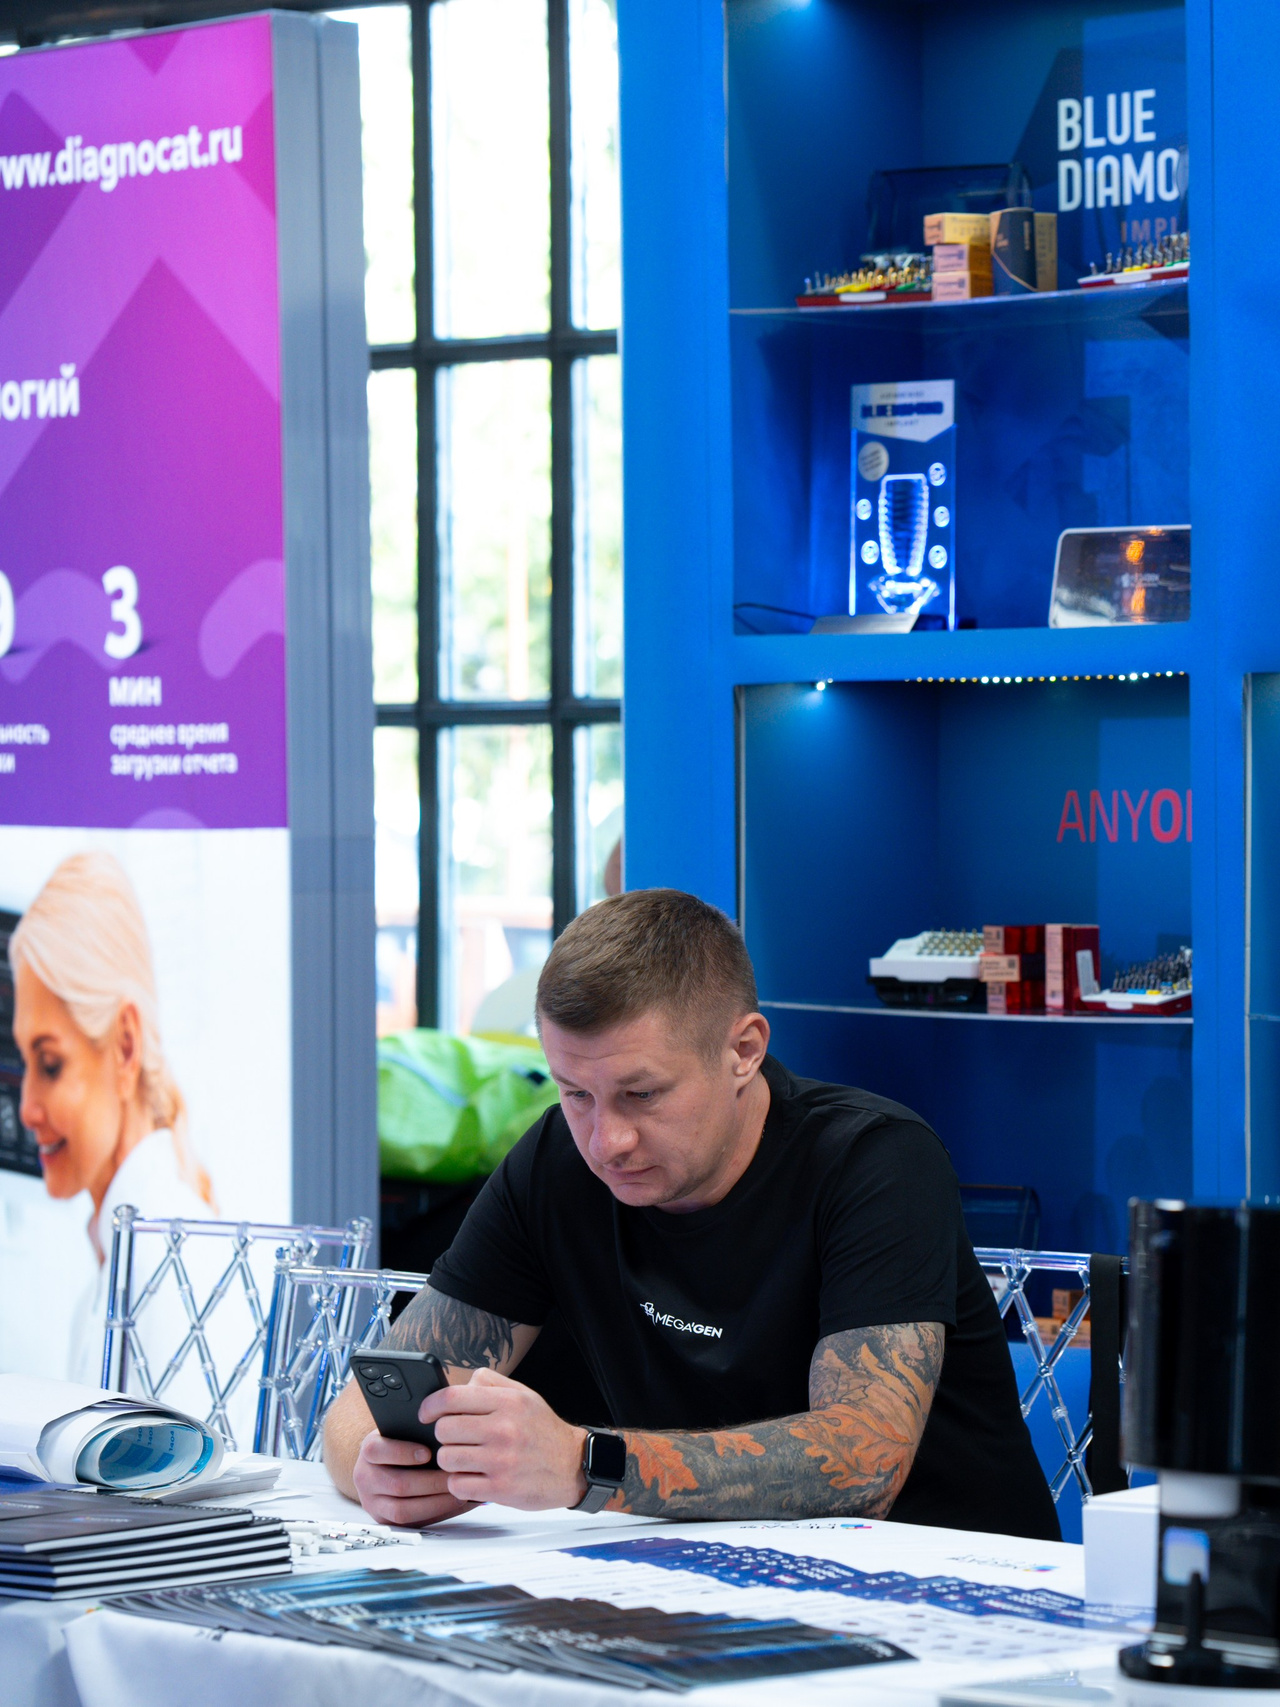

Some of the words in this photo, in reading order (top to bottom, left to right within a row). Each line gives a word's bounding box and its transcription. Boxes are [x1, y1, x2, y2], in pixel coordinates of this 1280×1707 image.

[1058, 88, 1156, 151] BLUE
[0, 362, 80, 421] огий
[102, 565, 143, 660] 3
[1057, 788, 1192, 843] ANYO
